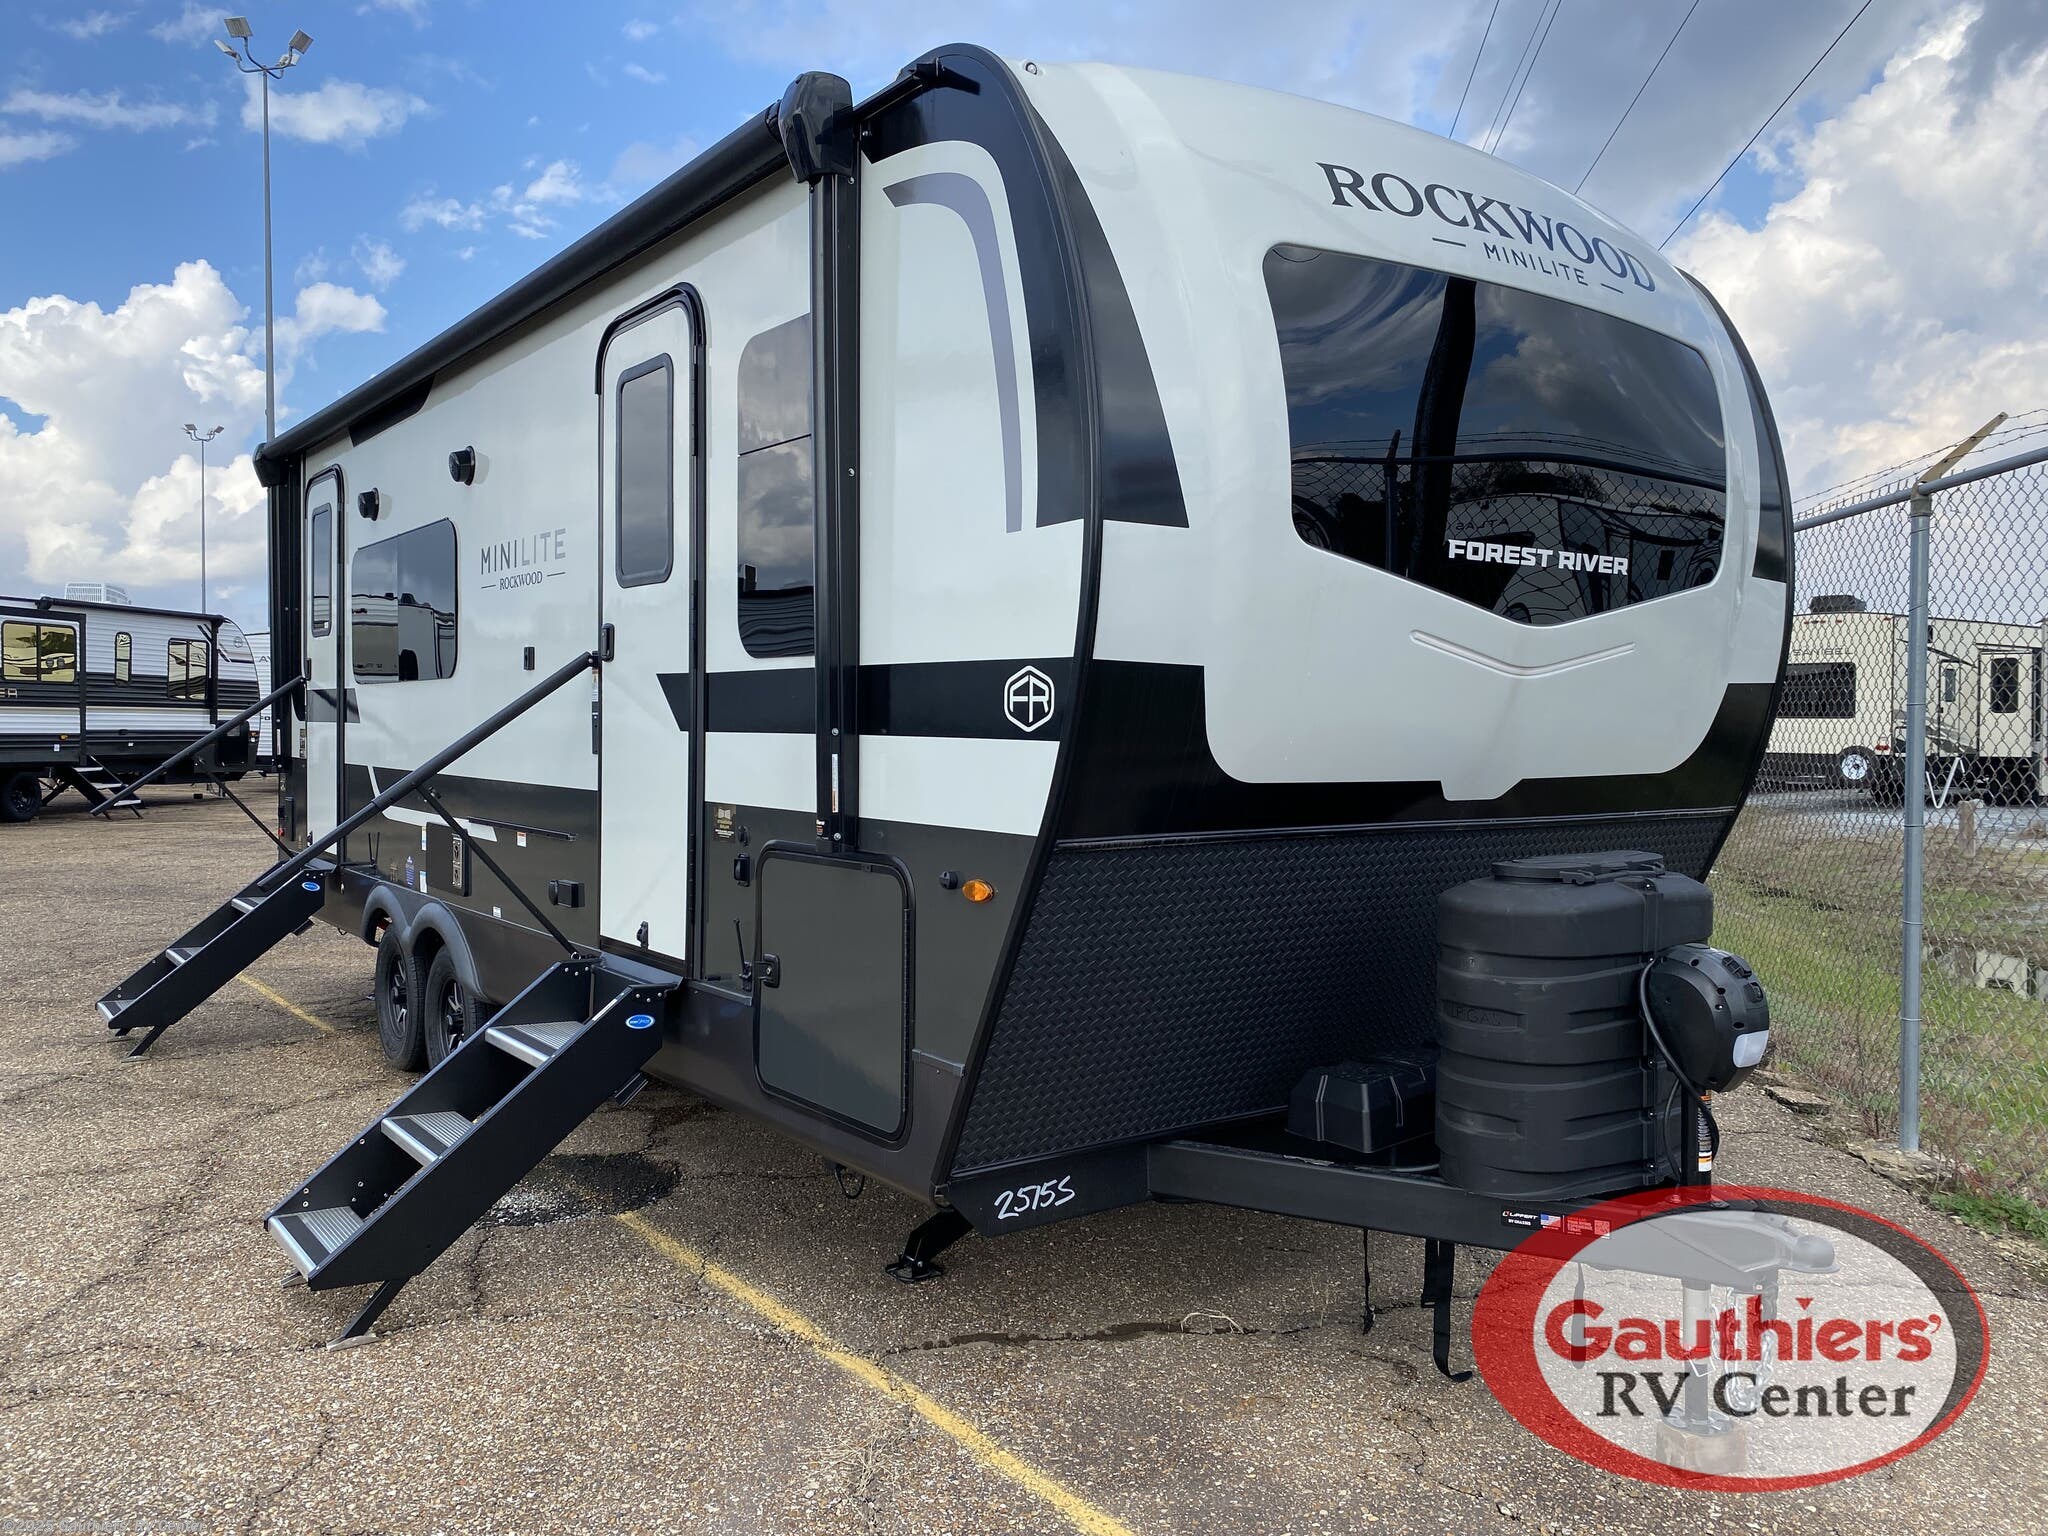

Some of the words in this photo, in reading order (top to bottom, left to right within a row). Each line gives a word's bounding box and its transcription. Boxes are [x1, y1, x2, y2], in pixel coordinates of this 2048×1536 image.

[1315, 161, 1656, 292] ROCKWOOD
[1482, 242, 1589, 286] MINILITE
[481, 528, 566, 575] MINILITE
[1448, 539, 1554, 568] FOREST
[1558, 551, 1629, 576] RIVER
[499, 571, 543, 590] ROCKWOOD
